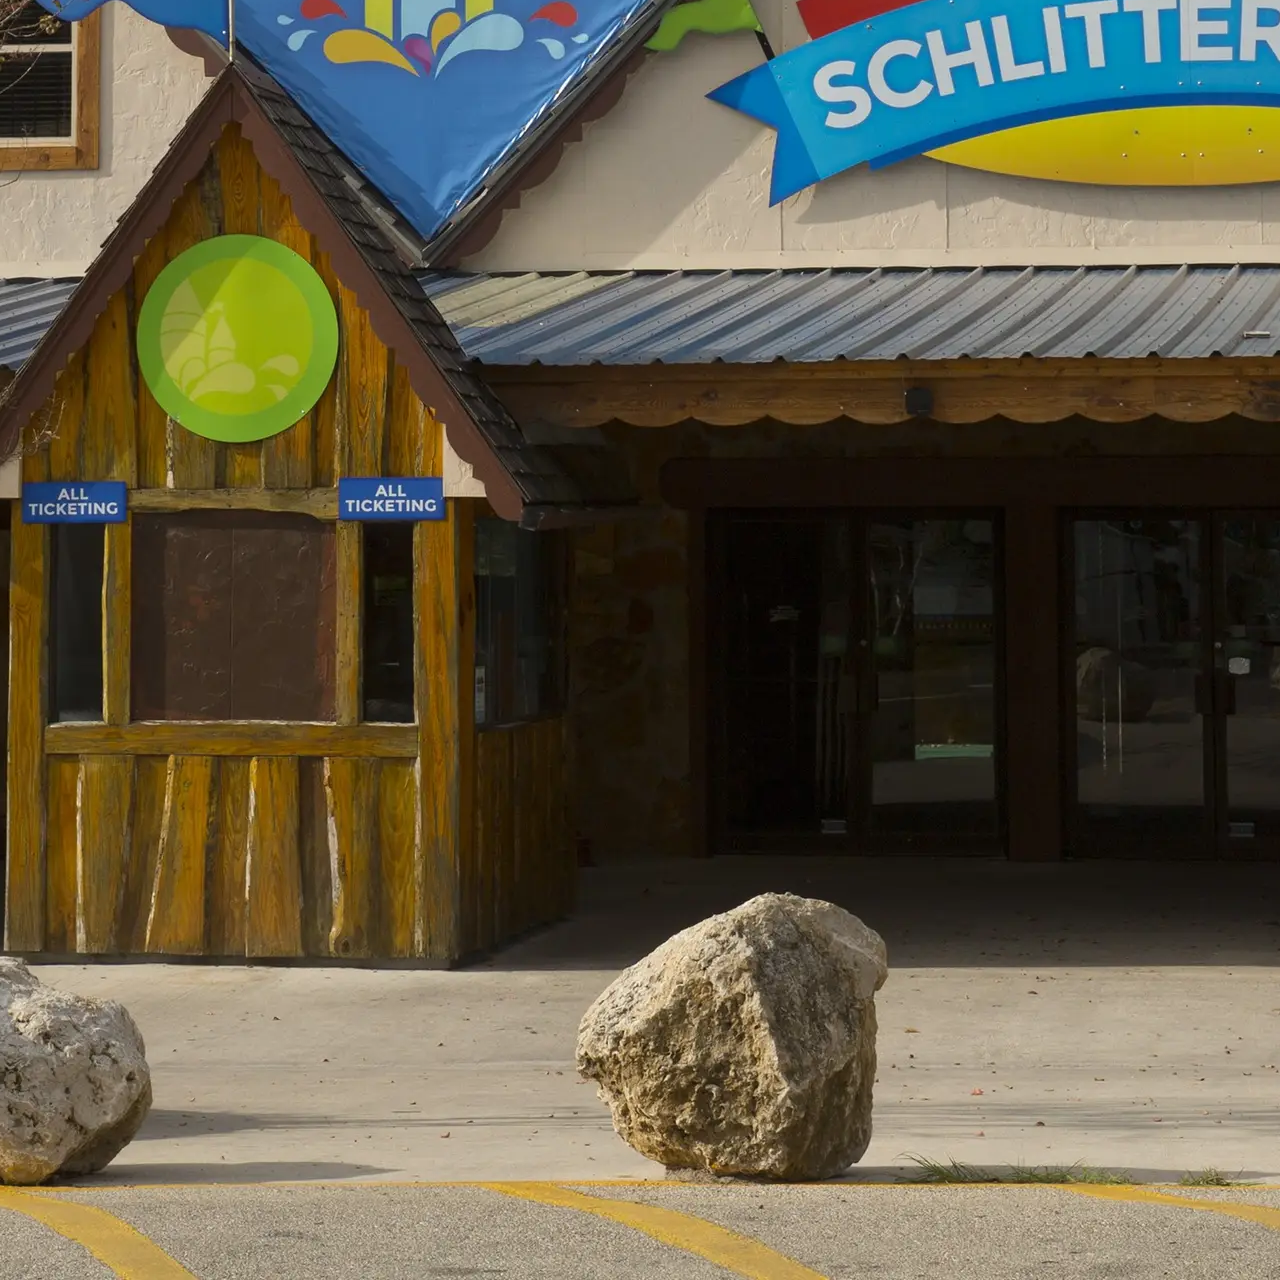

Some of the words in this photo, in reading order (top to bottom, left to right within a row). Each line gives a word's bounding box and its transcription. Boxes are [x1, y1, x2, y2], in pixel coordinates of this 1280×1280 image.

[58, 488, 89, 500] ALL
[374, 484, 406, 497] ALL
[29, 502, 119, 515] TICKETING
[345, 499, 437, 512] TICKETING
